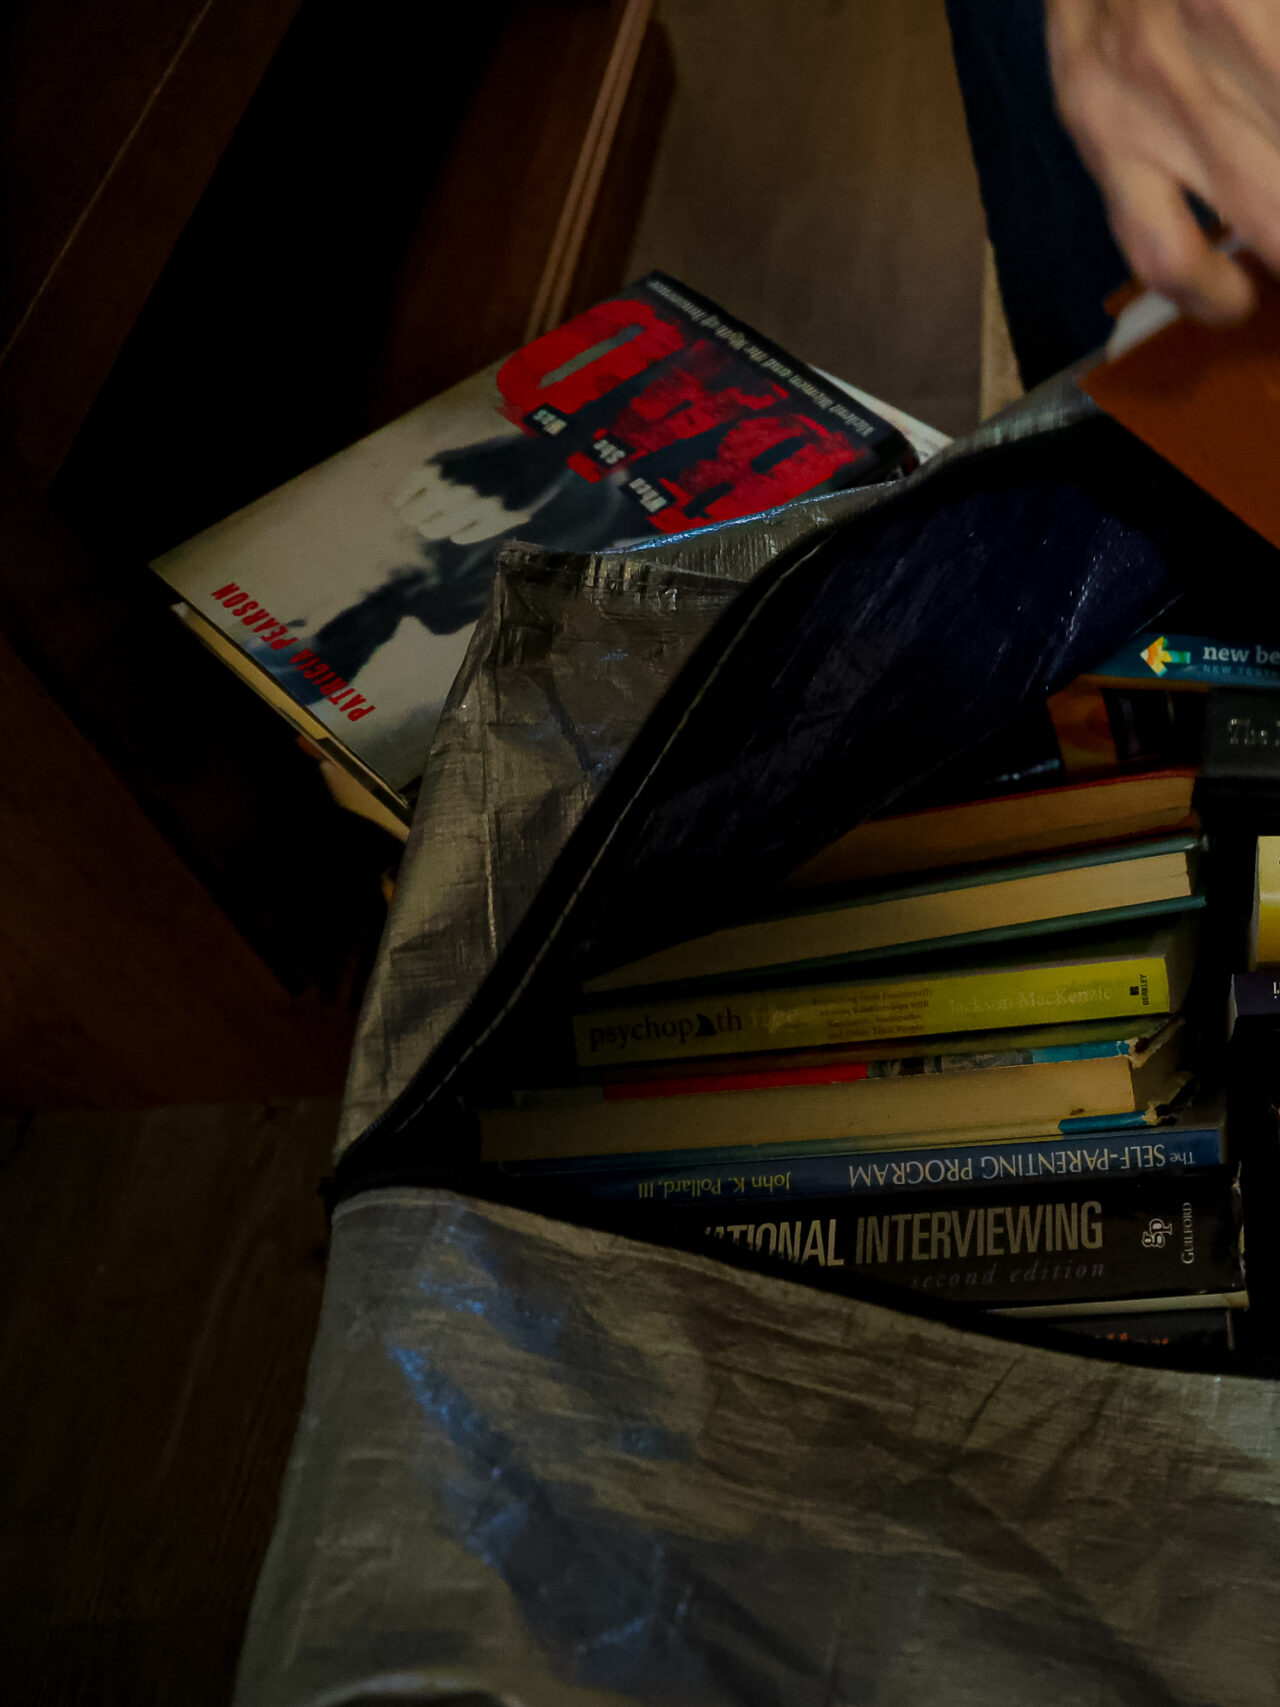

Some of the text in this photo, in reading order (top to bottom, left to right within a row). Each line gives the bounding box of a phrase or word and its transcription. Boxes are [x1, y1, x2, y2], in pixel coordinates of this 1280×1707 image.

[591, 437, 628, 466] She
[627, 476, 669, 514] When
[209, 582, 376, 723] PATRICIA PEARSON
[1202, 644, 1250, 663] new
[1138, 973, 1150, 1006] BERKLEY
[637, 1142, 1198, 1199] The SELF-PARENTING PROGRAM John K. Pollard, III
[854, 1200, 1103, 1266] INTERVIEWING
[1180, 1201, 1194, 1264] GUILFORD
[909, 1260, 1106, 1291] second edition
